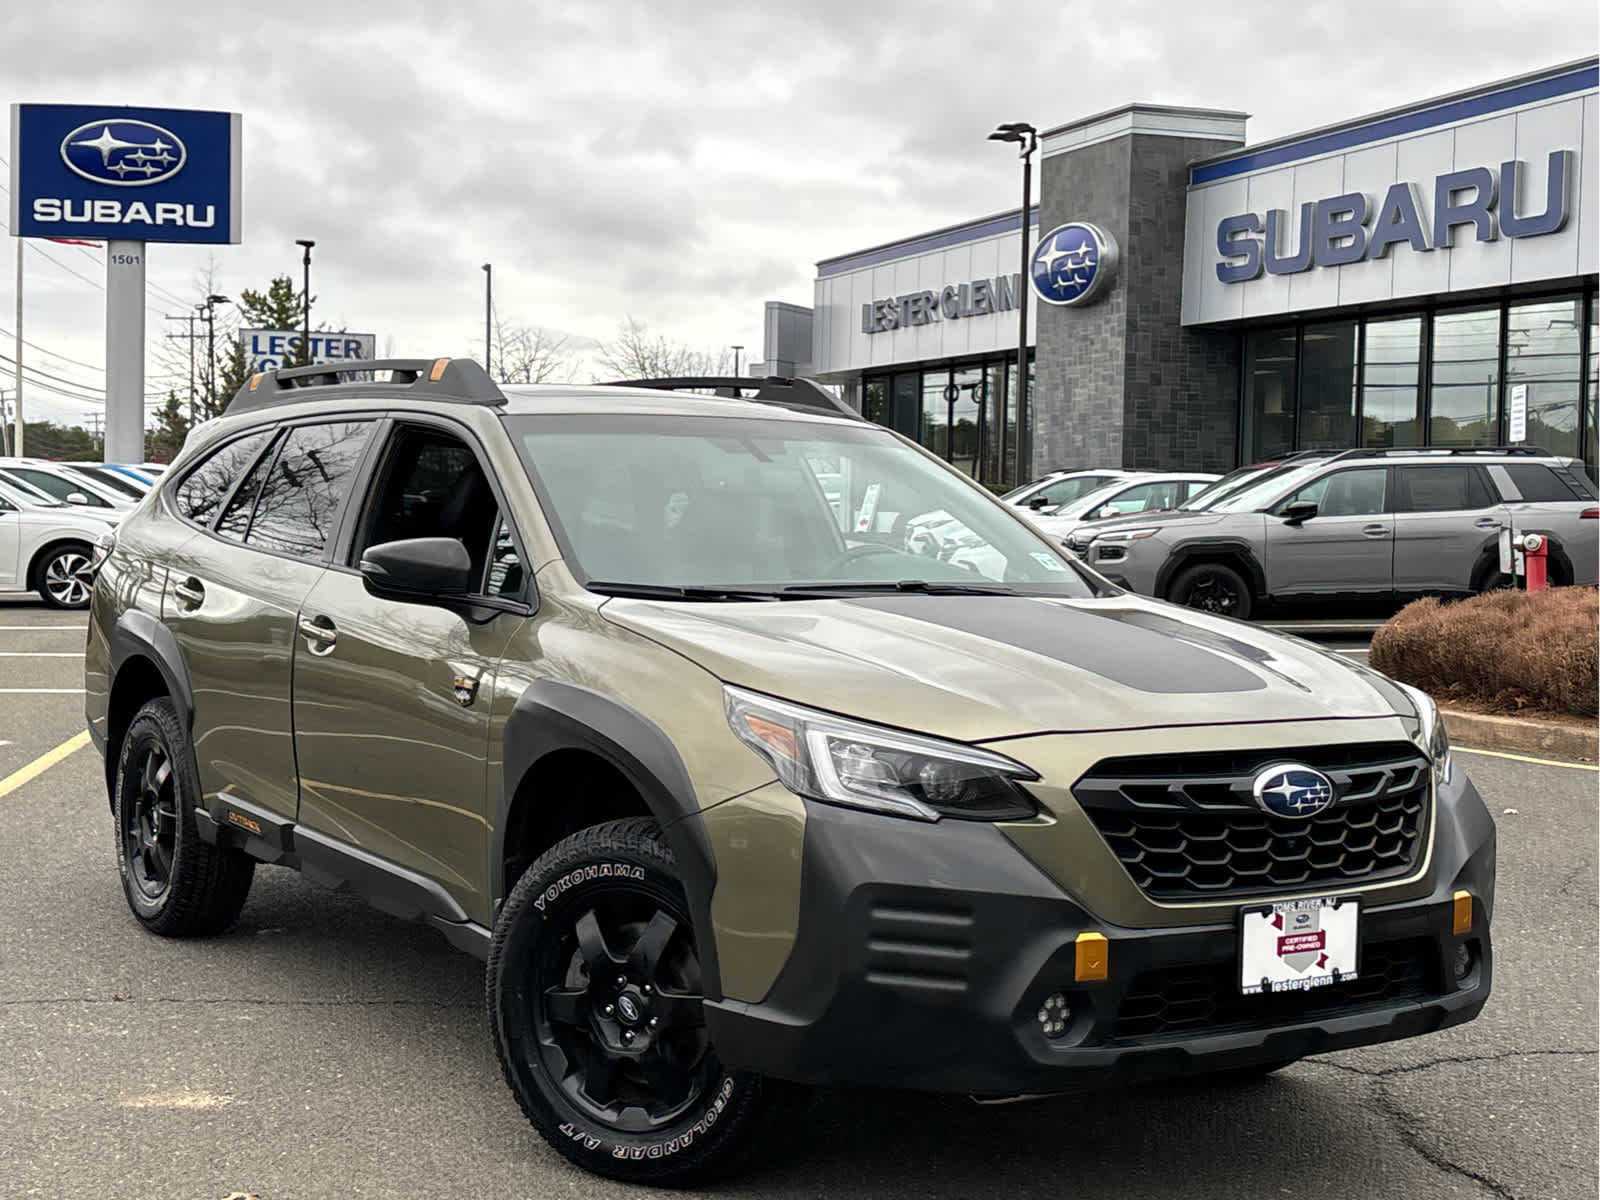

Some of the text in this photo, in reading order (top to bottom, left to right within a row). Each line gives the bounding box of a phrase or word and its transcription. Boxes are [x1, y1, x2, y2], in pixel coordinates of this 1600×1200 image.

[33, 198, 215, 227] SUBARU
[1216, 150, 1573, 284] SUBARU
[111, 254, 140, 265] 1501
[862, 272, 1021, 334] LESTER GLENN
[252, 335, 362, 359] LESTER
[534, 863, 646, 911] YOKOHAMA
[1281, 941, 1321, 952] PRE-OWNED
[1285, 934, 1318, 945] CERTIFIED
[559, 1077, 735, 1160] GEOLANDAR A/T
